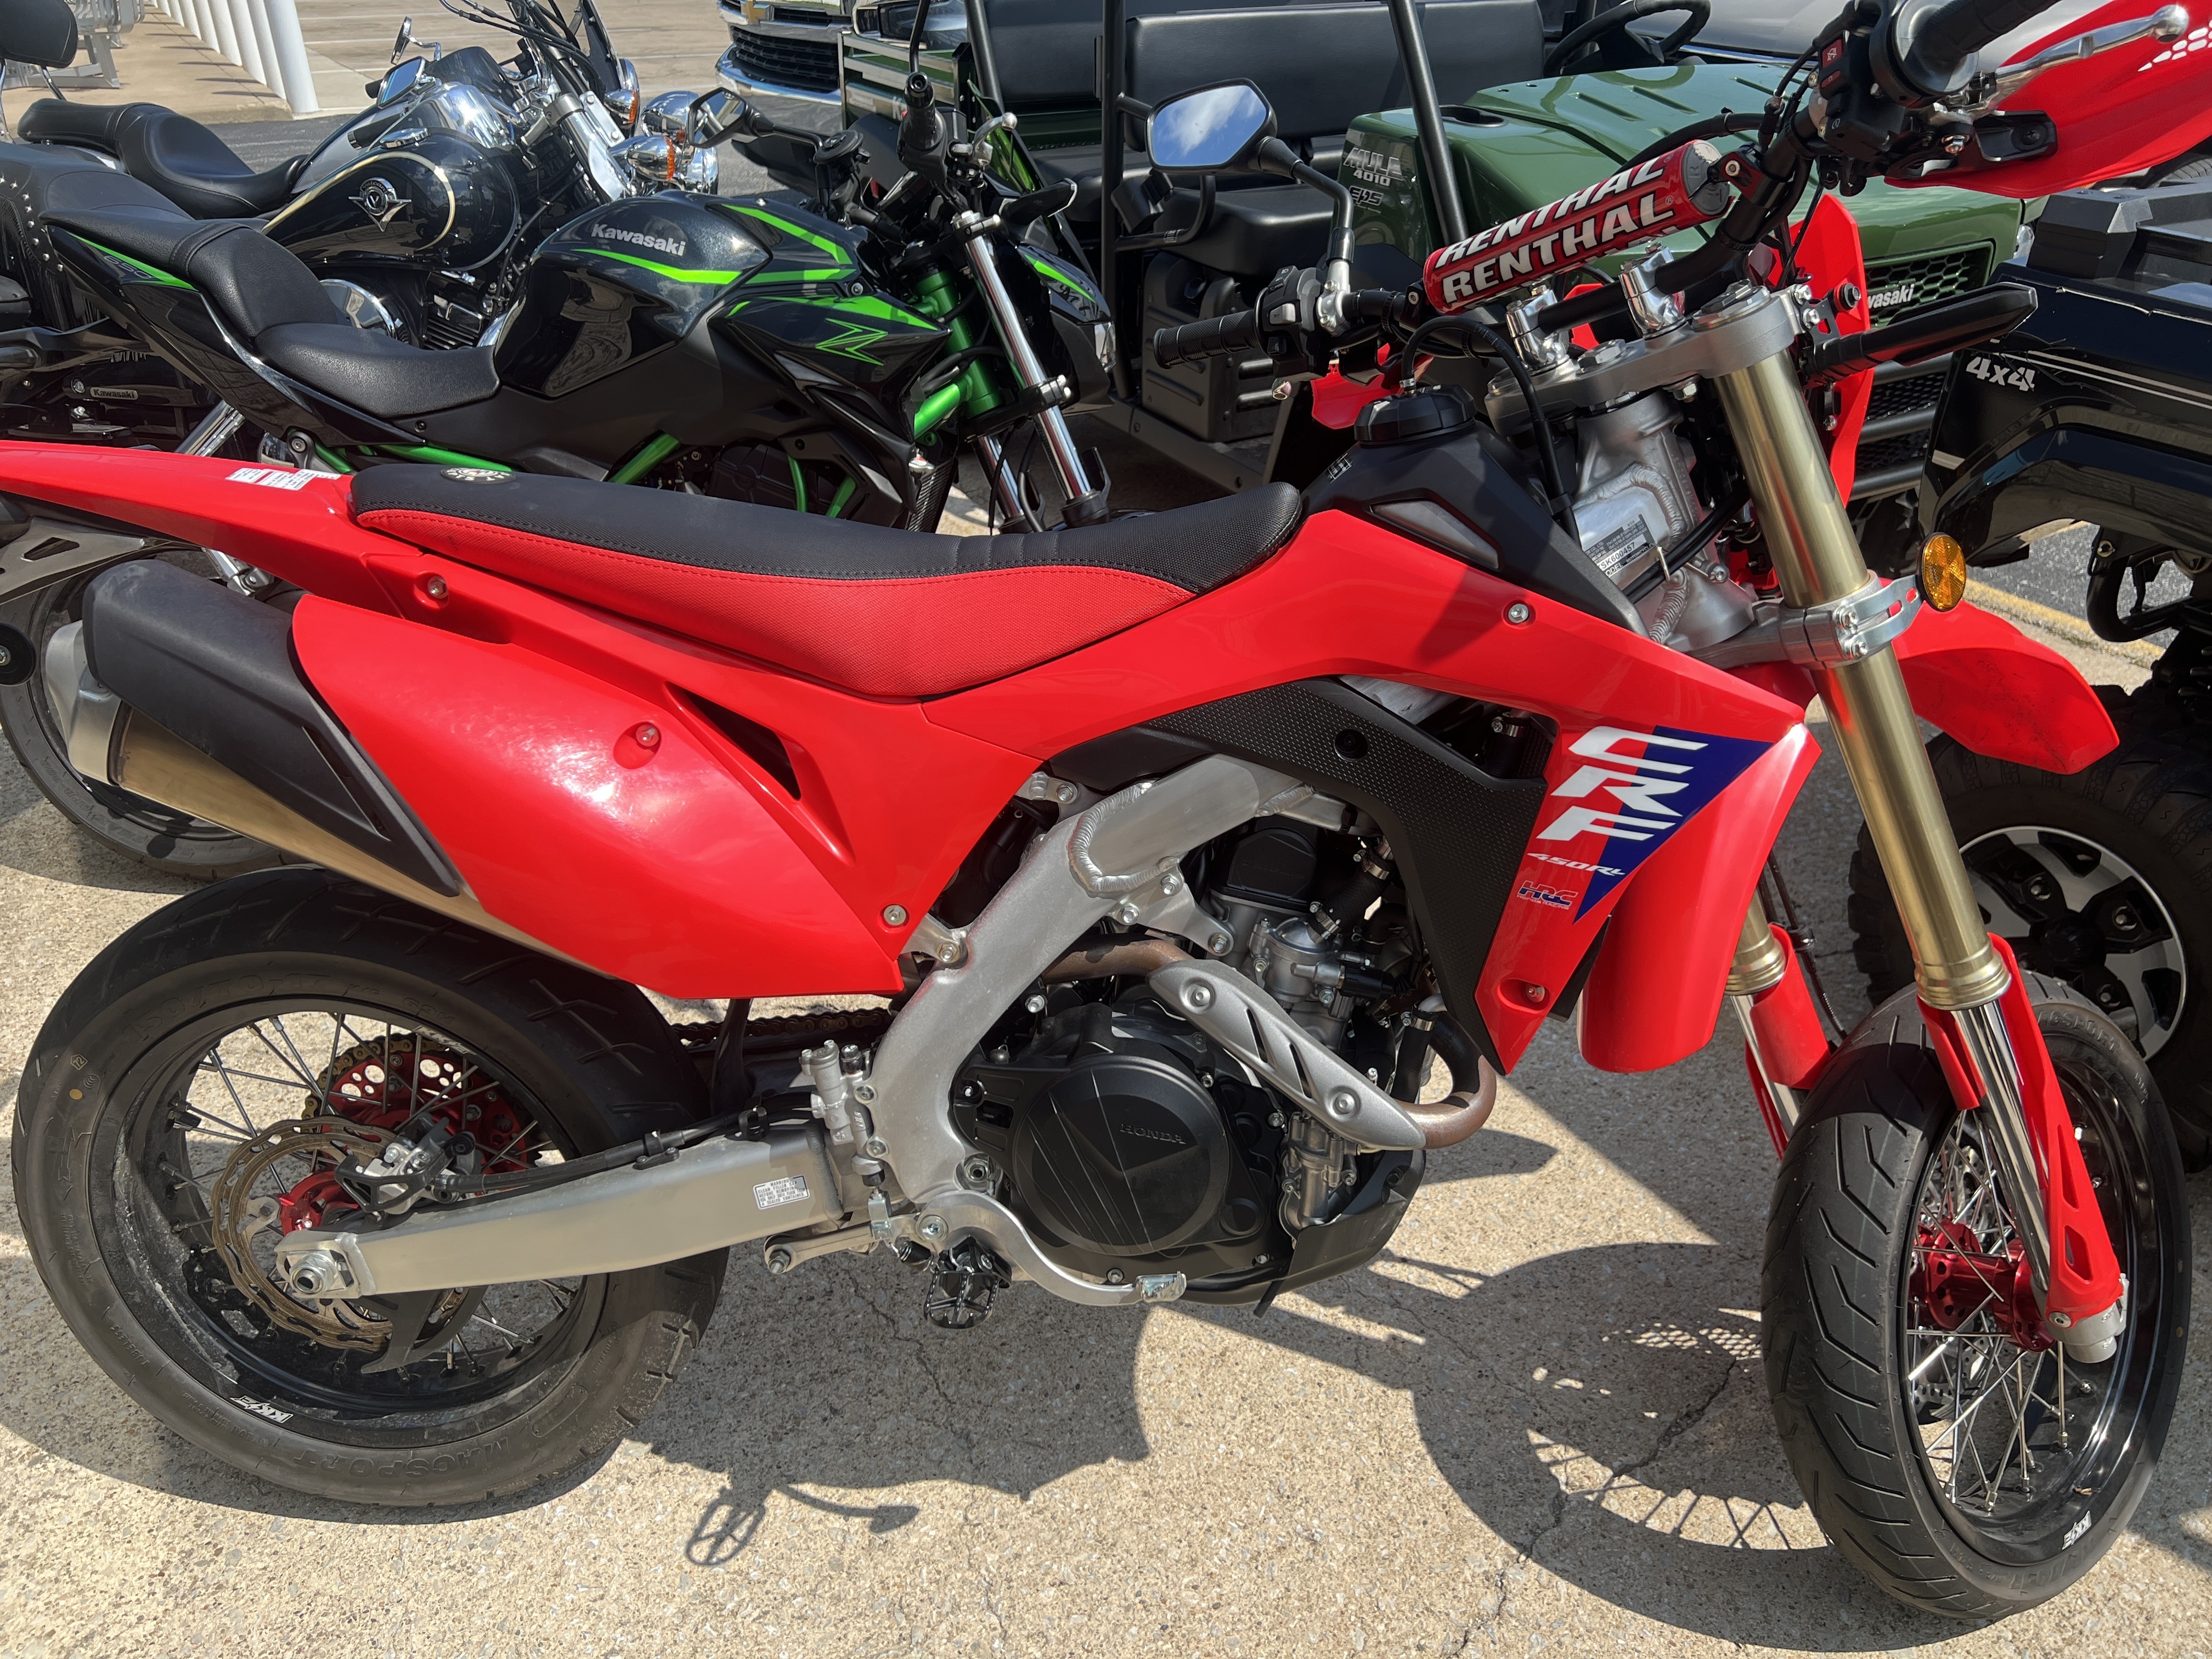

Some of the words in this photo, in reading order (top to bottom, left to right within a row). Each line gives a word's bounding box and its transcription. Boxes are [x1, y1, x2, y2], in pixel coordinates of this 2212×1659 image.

[1343, 147, 1404, 181] MULE
[1353, 169, 1391, 187] 4010
[1435, 156, 1664, 269] RENTHAL
[591, 223, 686, 257] Kawasaki
[1442, 193, 1674, 304] RENTHAL
[1966, 356, 2035, 392] 4x4
[93, 388, 135, 399] Kawasaki
[1604, 562, 1624, 577] ODEL
[1536, 725, 1708, 841] CRF
[1527, 853, 1626, 877] 450RL
[1517, 879, 1579, 906] HRC
[1119, 1123, 1186, 1144] HONDA
